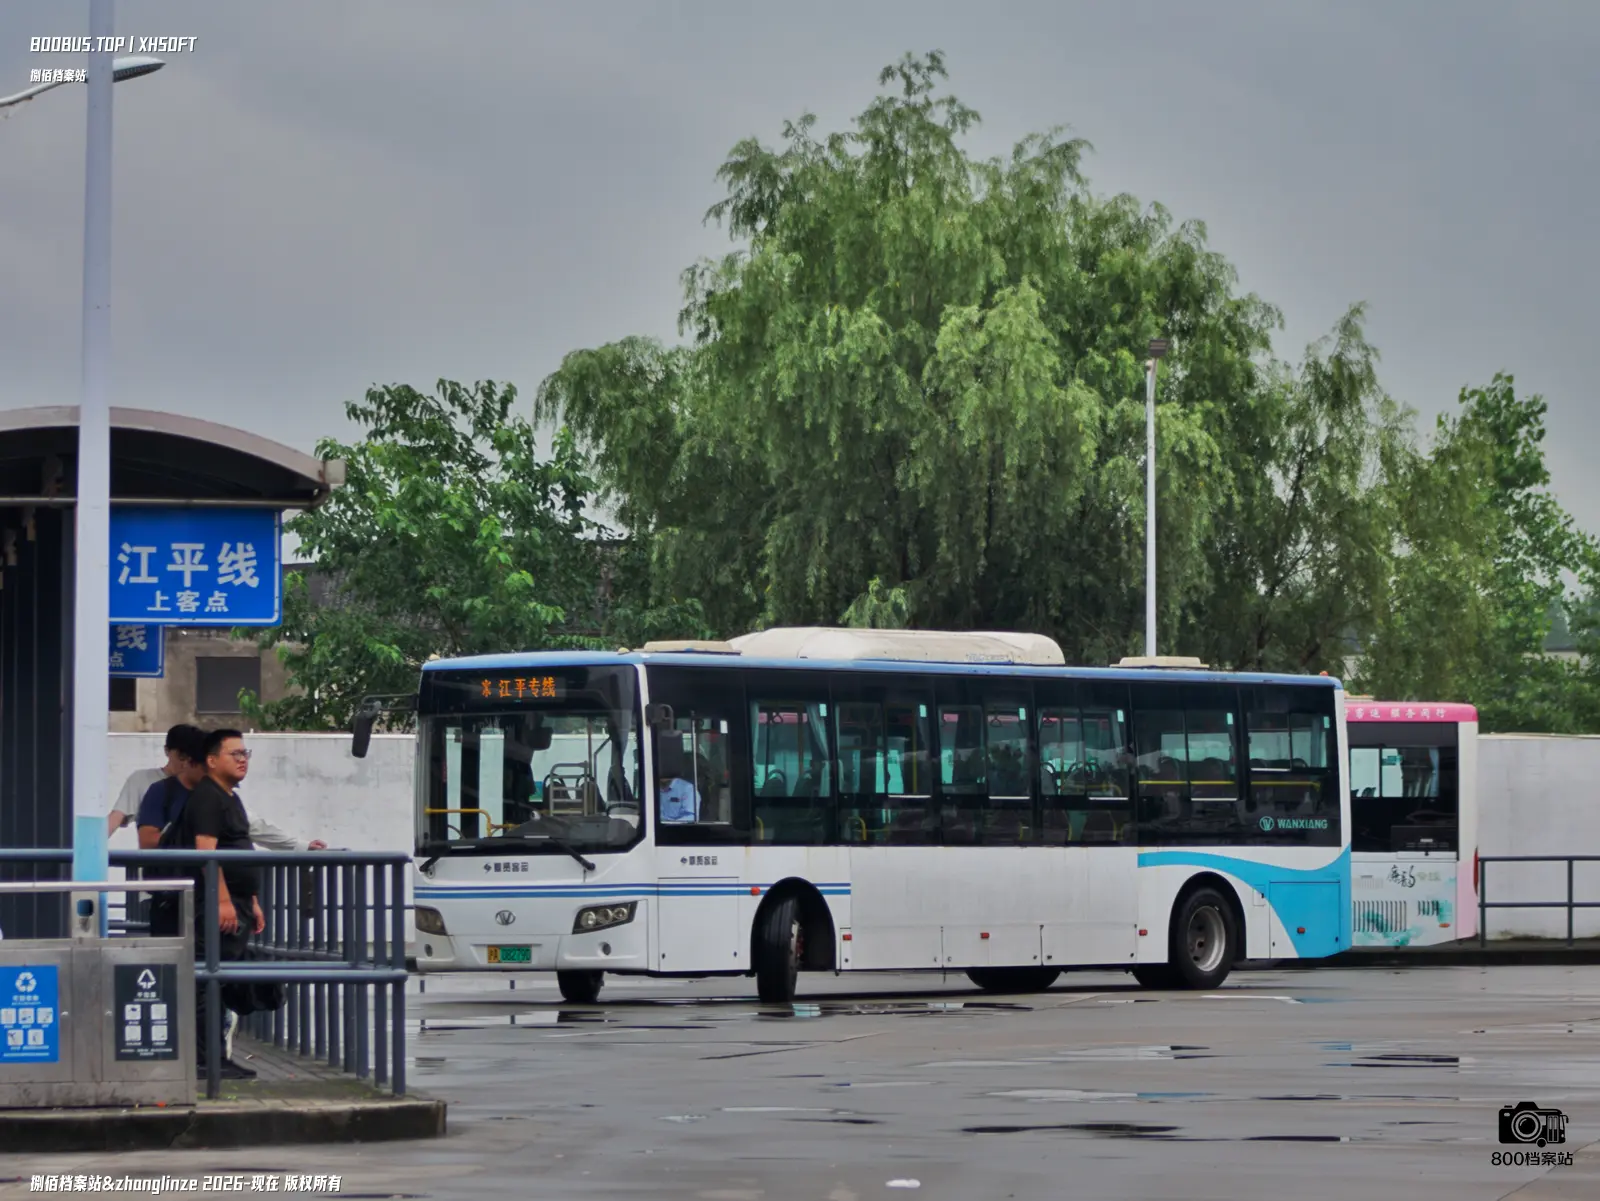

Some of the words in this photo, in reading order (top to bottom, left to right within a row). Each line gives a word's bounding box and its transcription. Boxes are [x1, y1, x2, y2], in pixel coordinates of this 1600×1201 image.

[117, 542, 260, 588] 江平线
[147, 590, 229, 612] 上客点
[499, 677, 556, 698] 江平专线
[1277, 819, 1328, 829] WANXIANG
